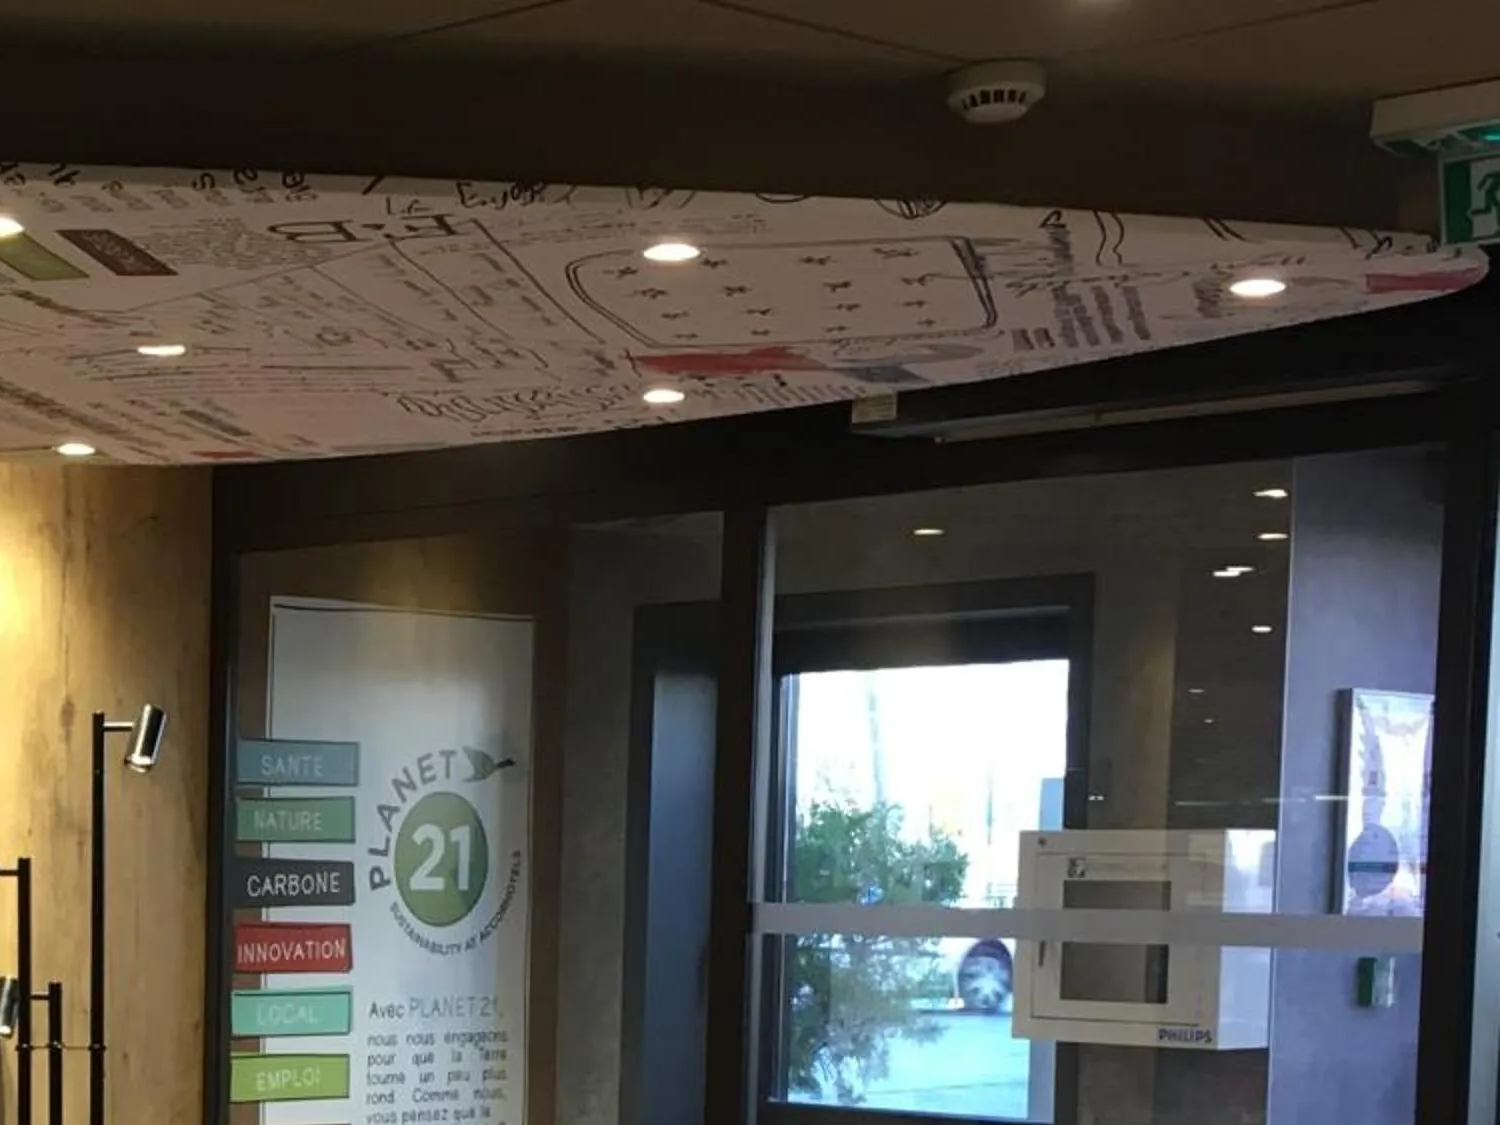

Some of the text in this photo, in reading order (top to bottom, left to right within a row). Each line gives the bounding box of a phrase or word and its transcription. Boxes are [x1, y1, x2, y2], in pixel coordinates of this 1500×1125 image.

[253, 809, 323, 832] NATURE
[368, 749, 457, 891] PLANET
[409, 822, 471, 892] 21
[246, 871, 341, 898] CARBONE
[237, 938, 346, 964] INNOVATION
[256, 1002, 319, 1026] LOCAL
[369, 1001, 404, 1019] Avec
[409, 996, 476, 1019] PLANET
[367, 1034, 398, 1047] nous
[406, 1032, 436, 1046] nous
[1158, 1028, 1213, 1043] PHILIPS
[367, 1053, 397, 1067] pour
[412, 1051, 435, 1067] que
[256, 1067, 320, 1092] EMPLOI
